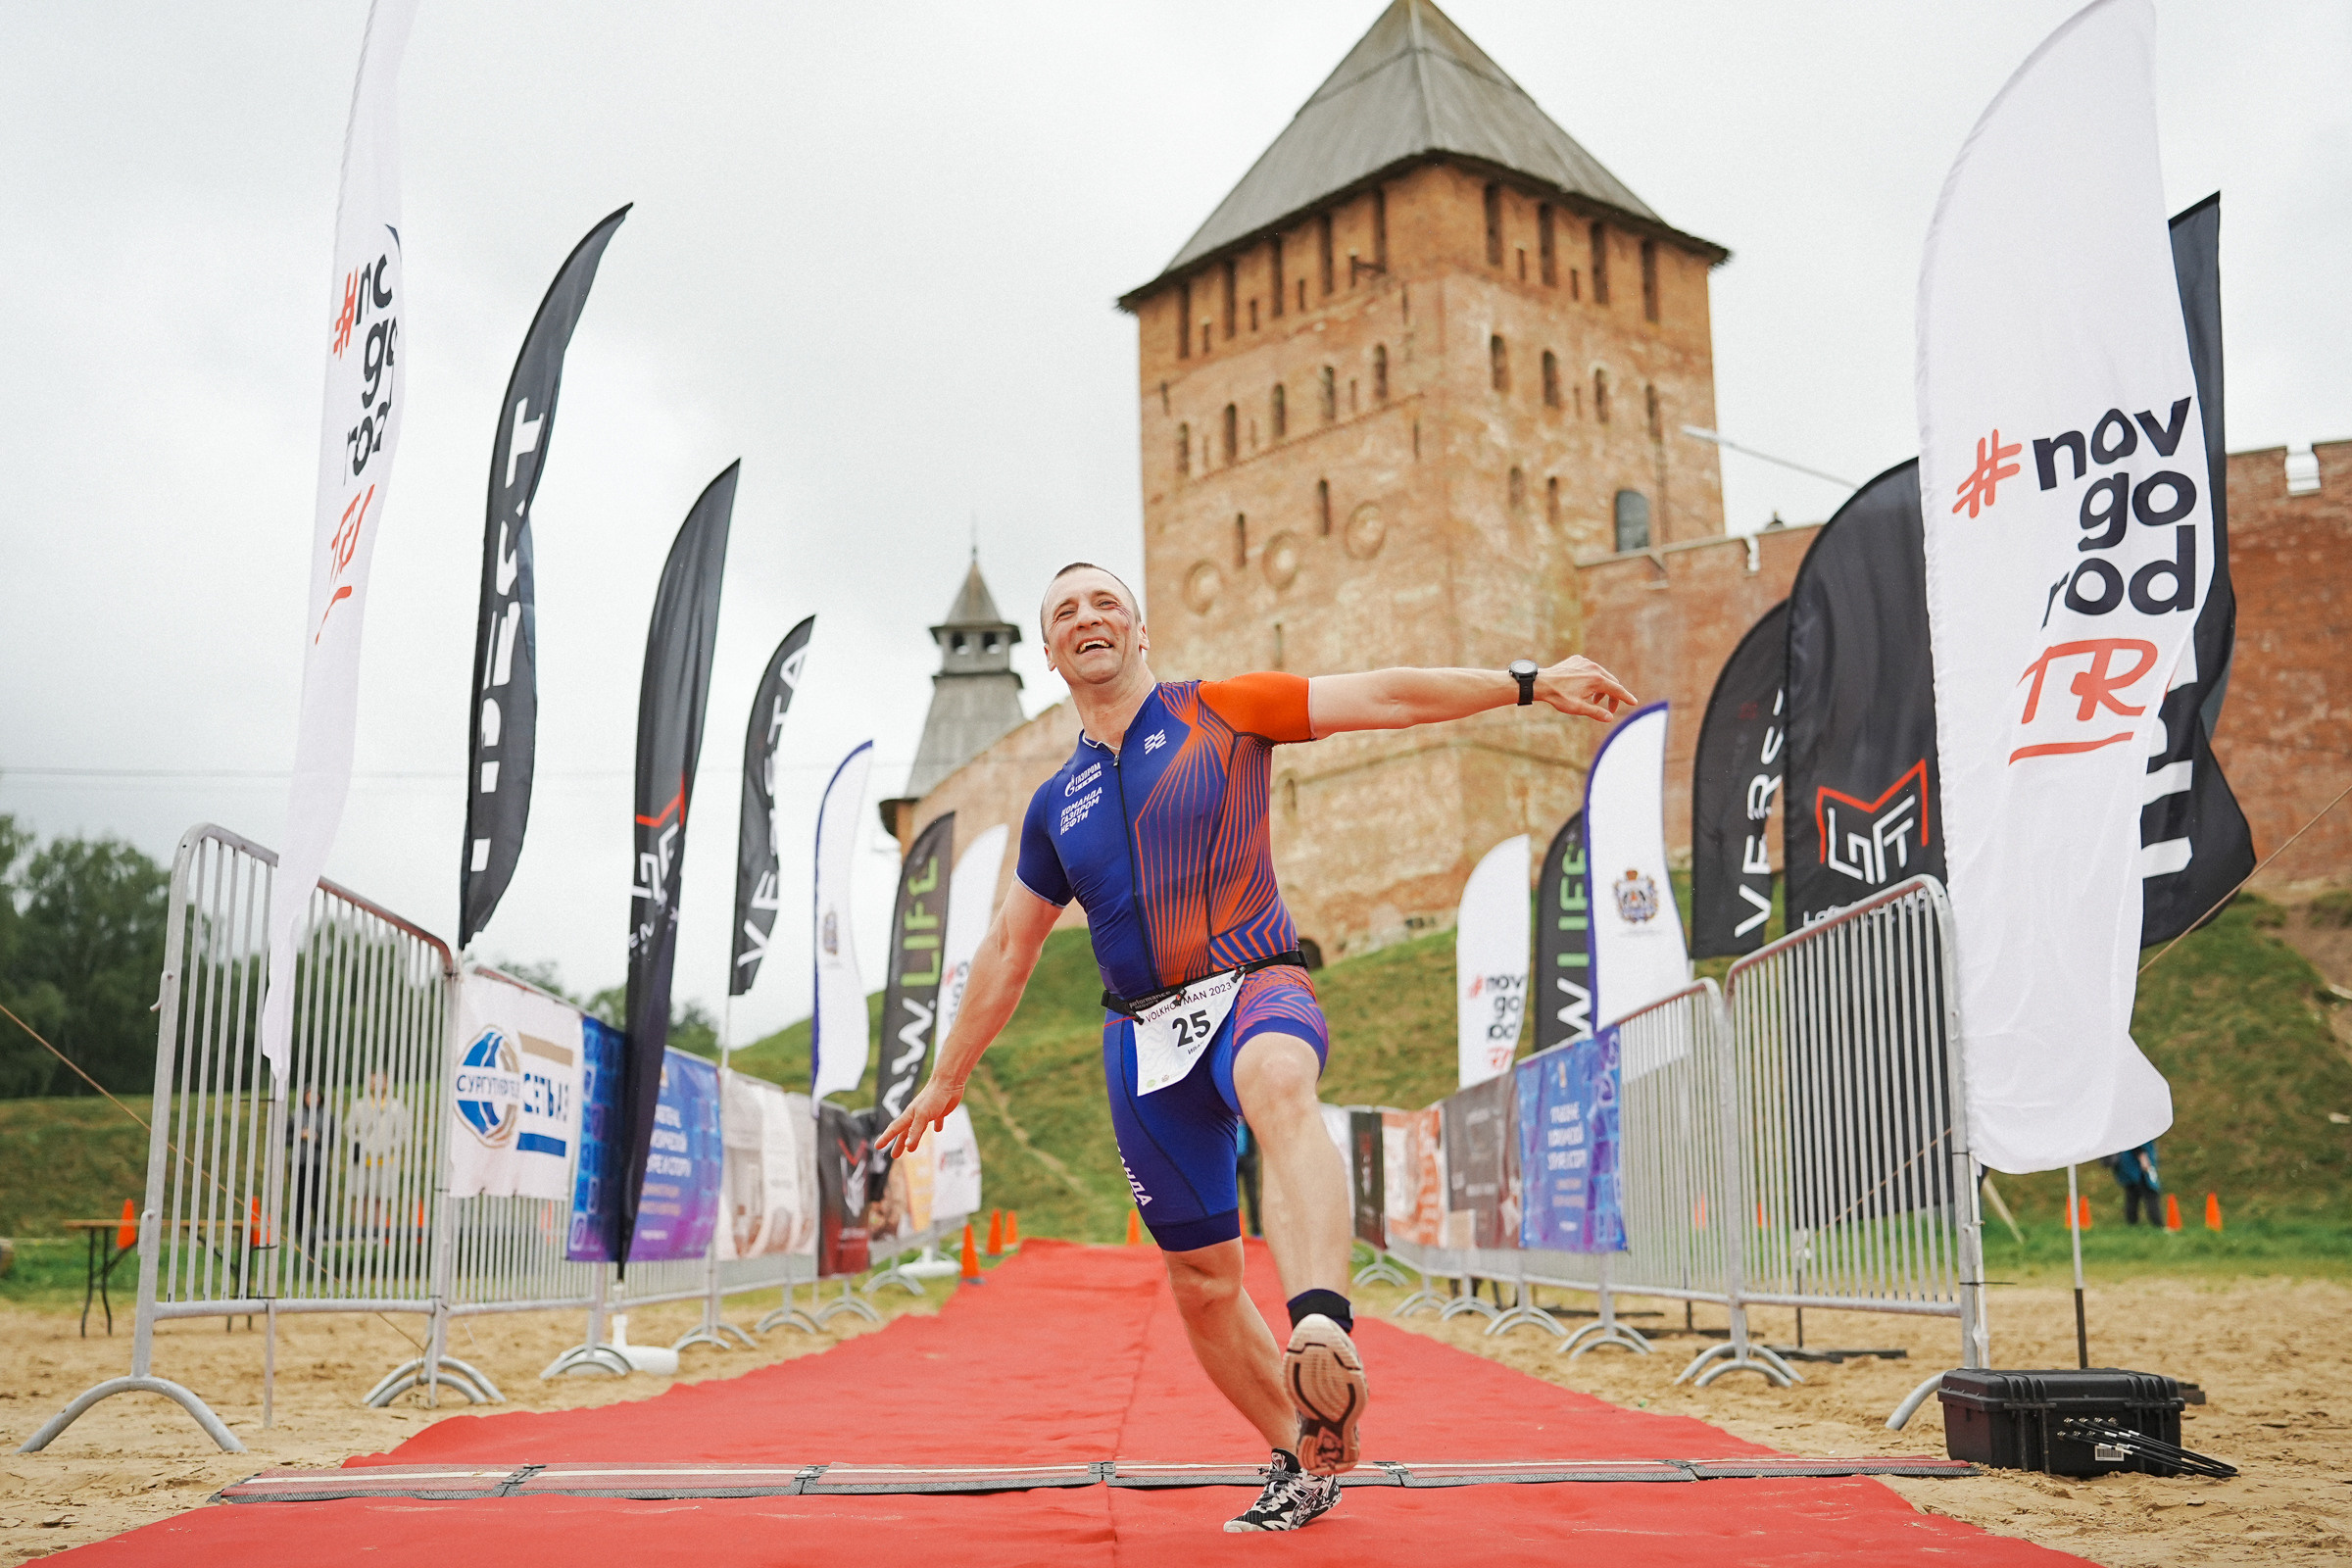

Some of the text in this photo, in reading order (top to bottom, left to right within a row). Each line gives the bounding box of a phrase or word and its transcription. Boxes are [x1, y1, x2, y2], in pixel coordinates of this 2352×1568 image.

[1952, 396, 2191, 519] #nov
[2078, 470, 2197, 551] go
[1075, 761, 1102, 785] ГАЗПРОМ
[1060, 786, 1102, 818] КОМАНДА
[1060, 795, 1100, 827] ГАЗПРОМ
[1060, 809, 1089, 835] НЕФТИ
[1146, 982, 1232, 1023] VOLKHOMAN 2023
[1172, 1009, 1211, 1048] 25
